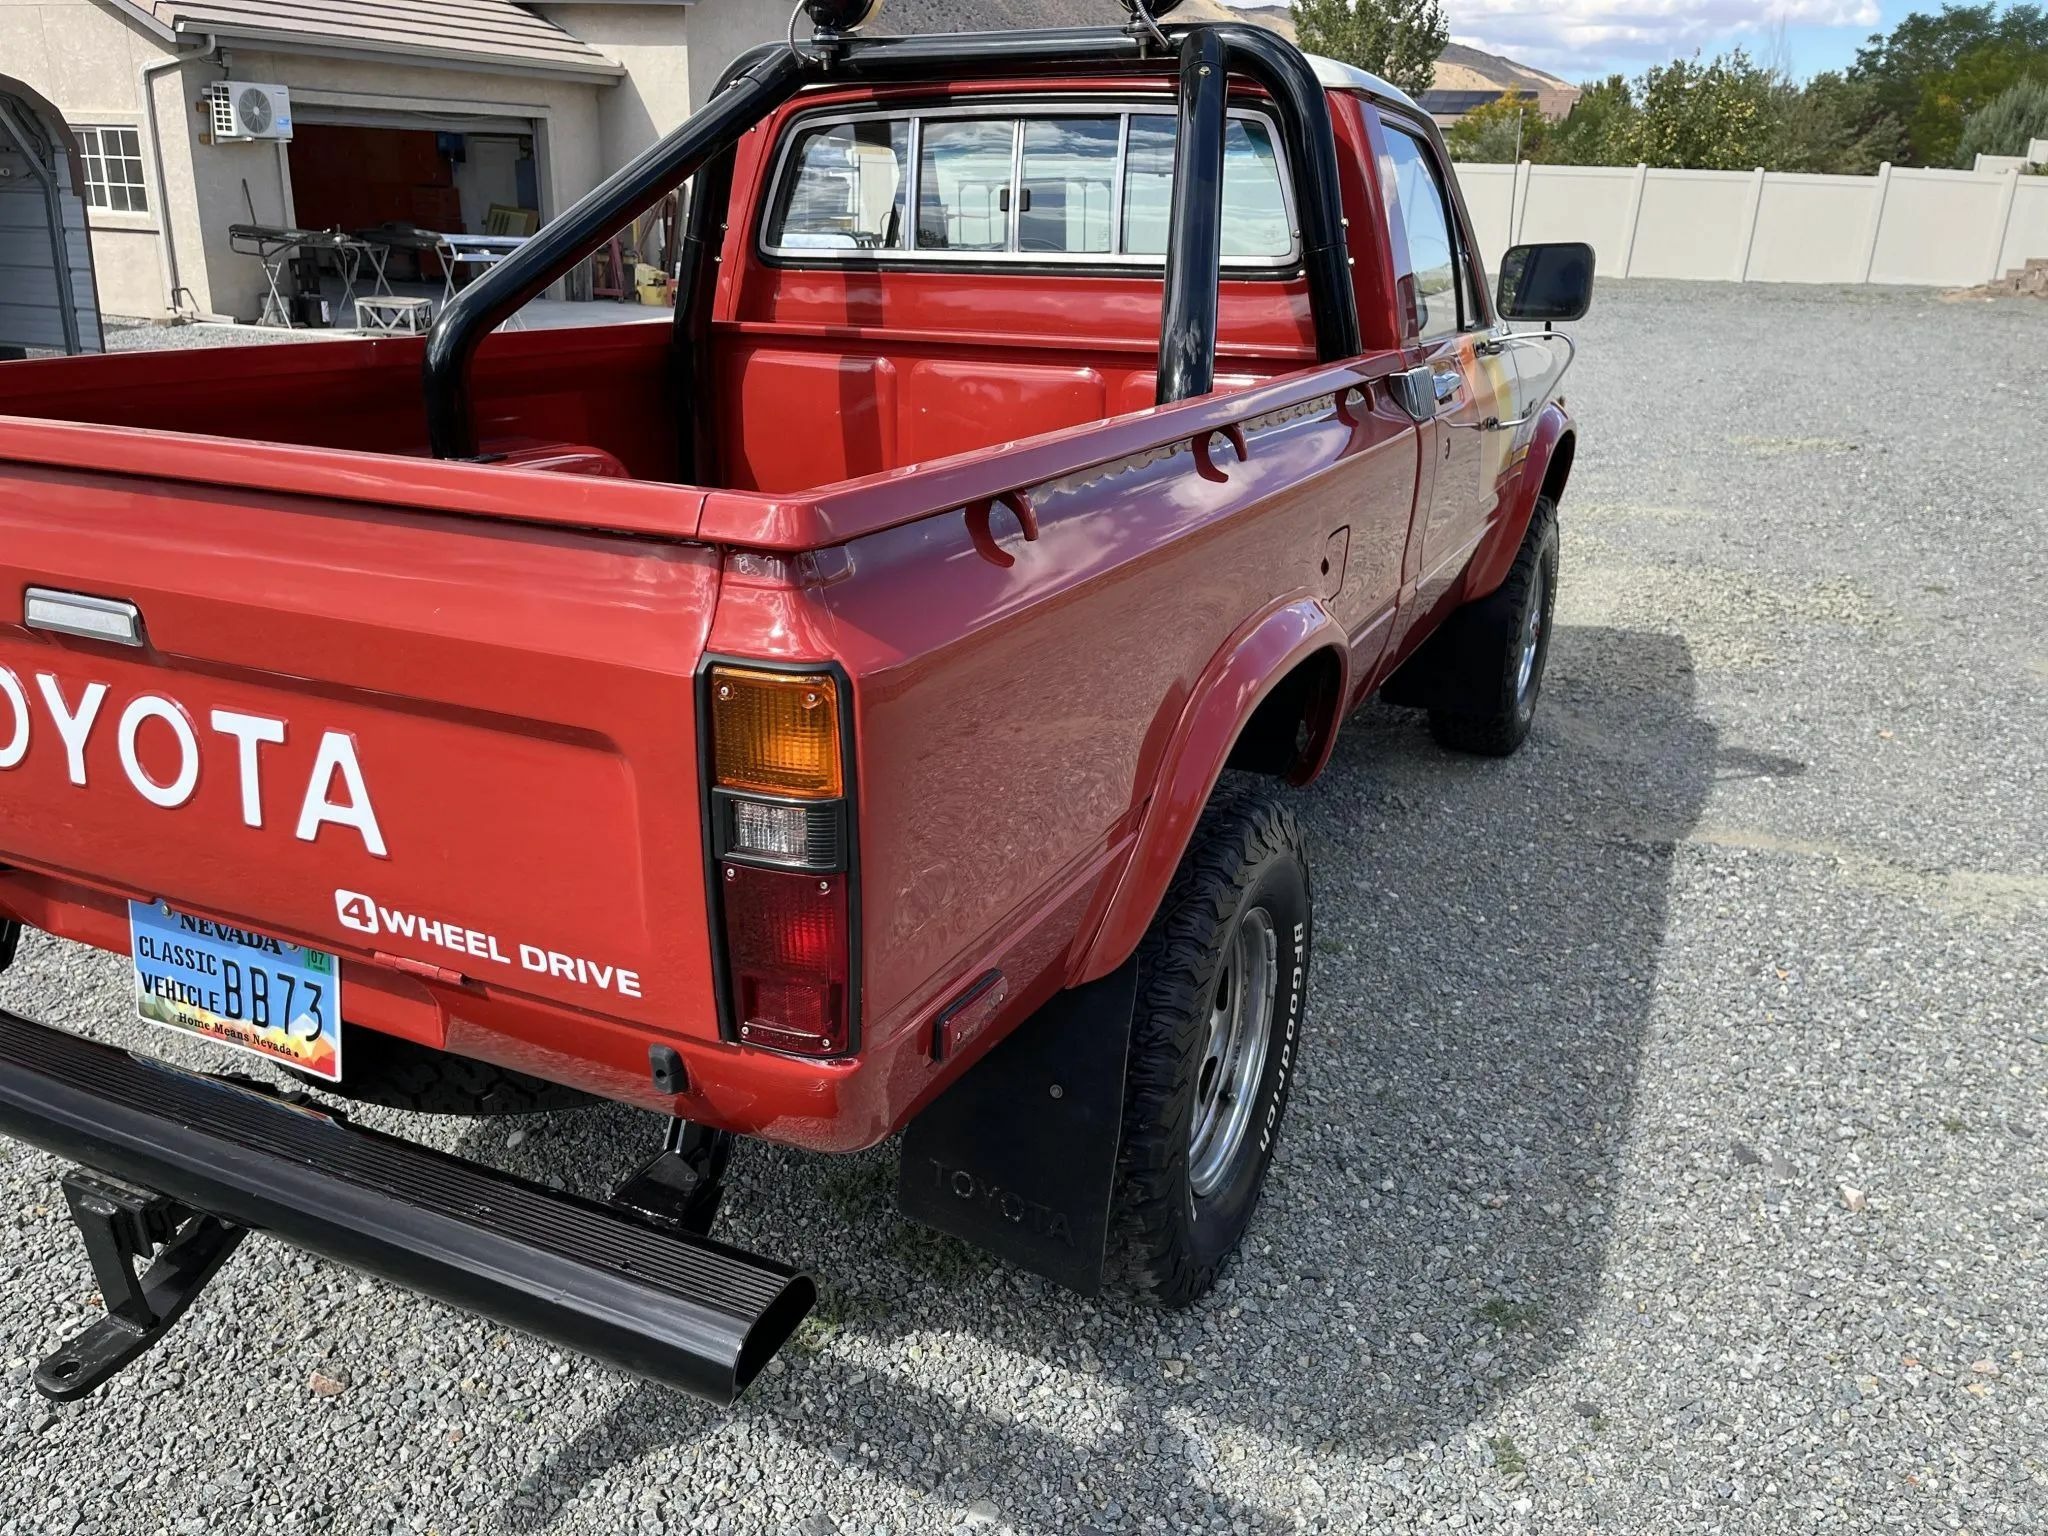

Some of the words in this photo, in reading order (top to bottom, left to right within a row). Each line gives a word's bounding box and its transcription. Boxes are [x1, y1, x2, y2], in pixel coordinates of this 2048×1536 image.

[138, 935, 218, 976] CLASSIC
[180, 914, 282, 955] NEVADA
[378, 906, 511, 964] WHEEL
[519, 943, 643, 998] DRIVE
[311, 950, 325, 965] 07
[141, 971, 221, 1014] VEHICLE
[221, 958, 323, 1042] BB73
[178, 1011, 210, 1031] Home
[214, 1022, 250, 1042] Means
[253, 1033, 292, 1056] Nevada
[1259, 921, 1304, 1153] BFGoodrich
[928, 1157, 1076, 1248] TOYOTA
